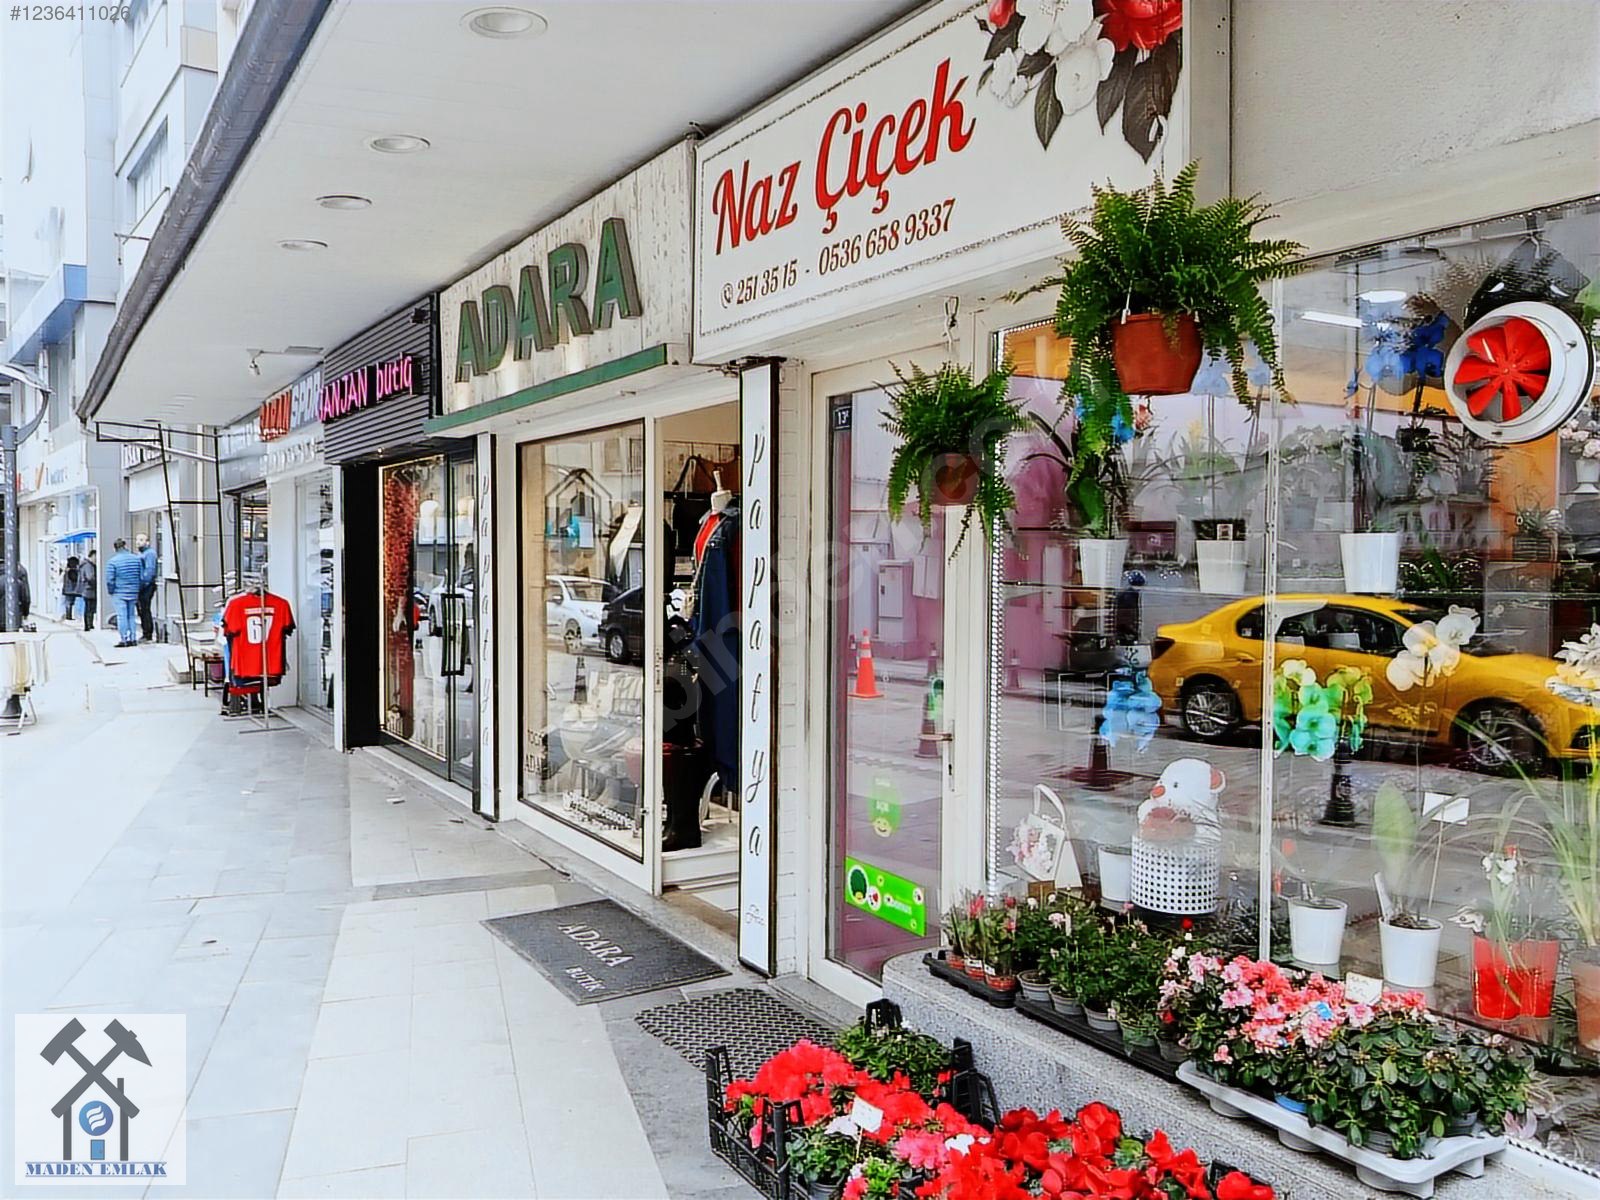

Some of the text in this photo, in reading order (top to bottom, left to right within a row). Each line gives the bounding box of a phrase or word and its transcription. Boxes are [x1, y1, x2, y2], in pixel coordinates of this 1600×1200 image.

[712, 57, 976, 256] Naz Çiçek
[455, 217, 643, 383] ADARA
[736, 270, 759, 305] 251
[761, 267, 779, 296] 35
[782, 259, 798, 290] 15
[818, 234, 862, 276] 0536
[865, 219, 900, 259] 658
[904, 198, 956, 246] 9337
[746, 433, 765, 856] papatya
[558, 921, 635, 968] ADARA
